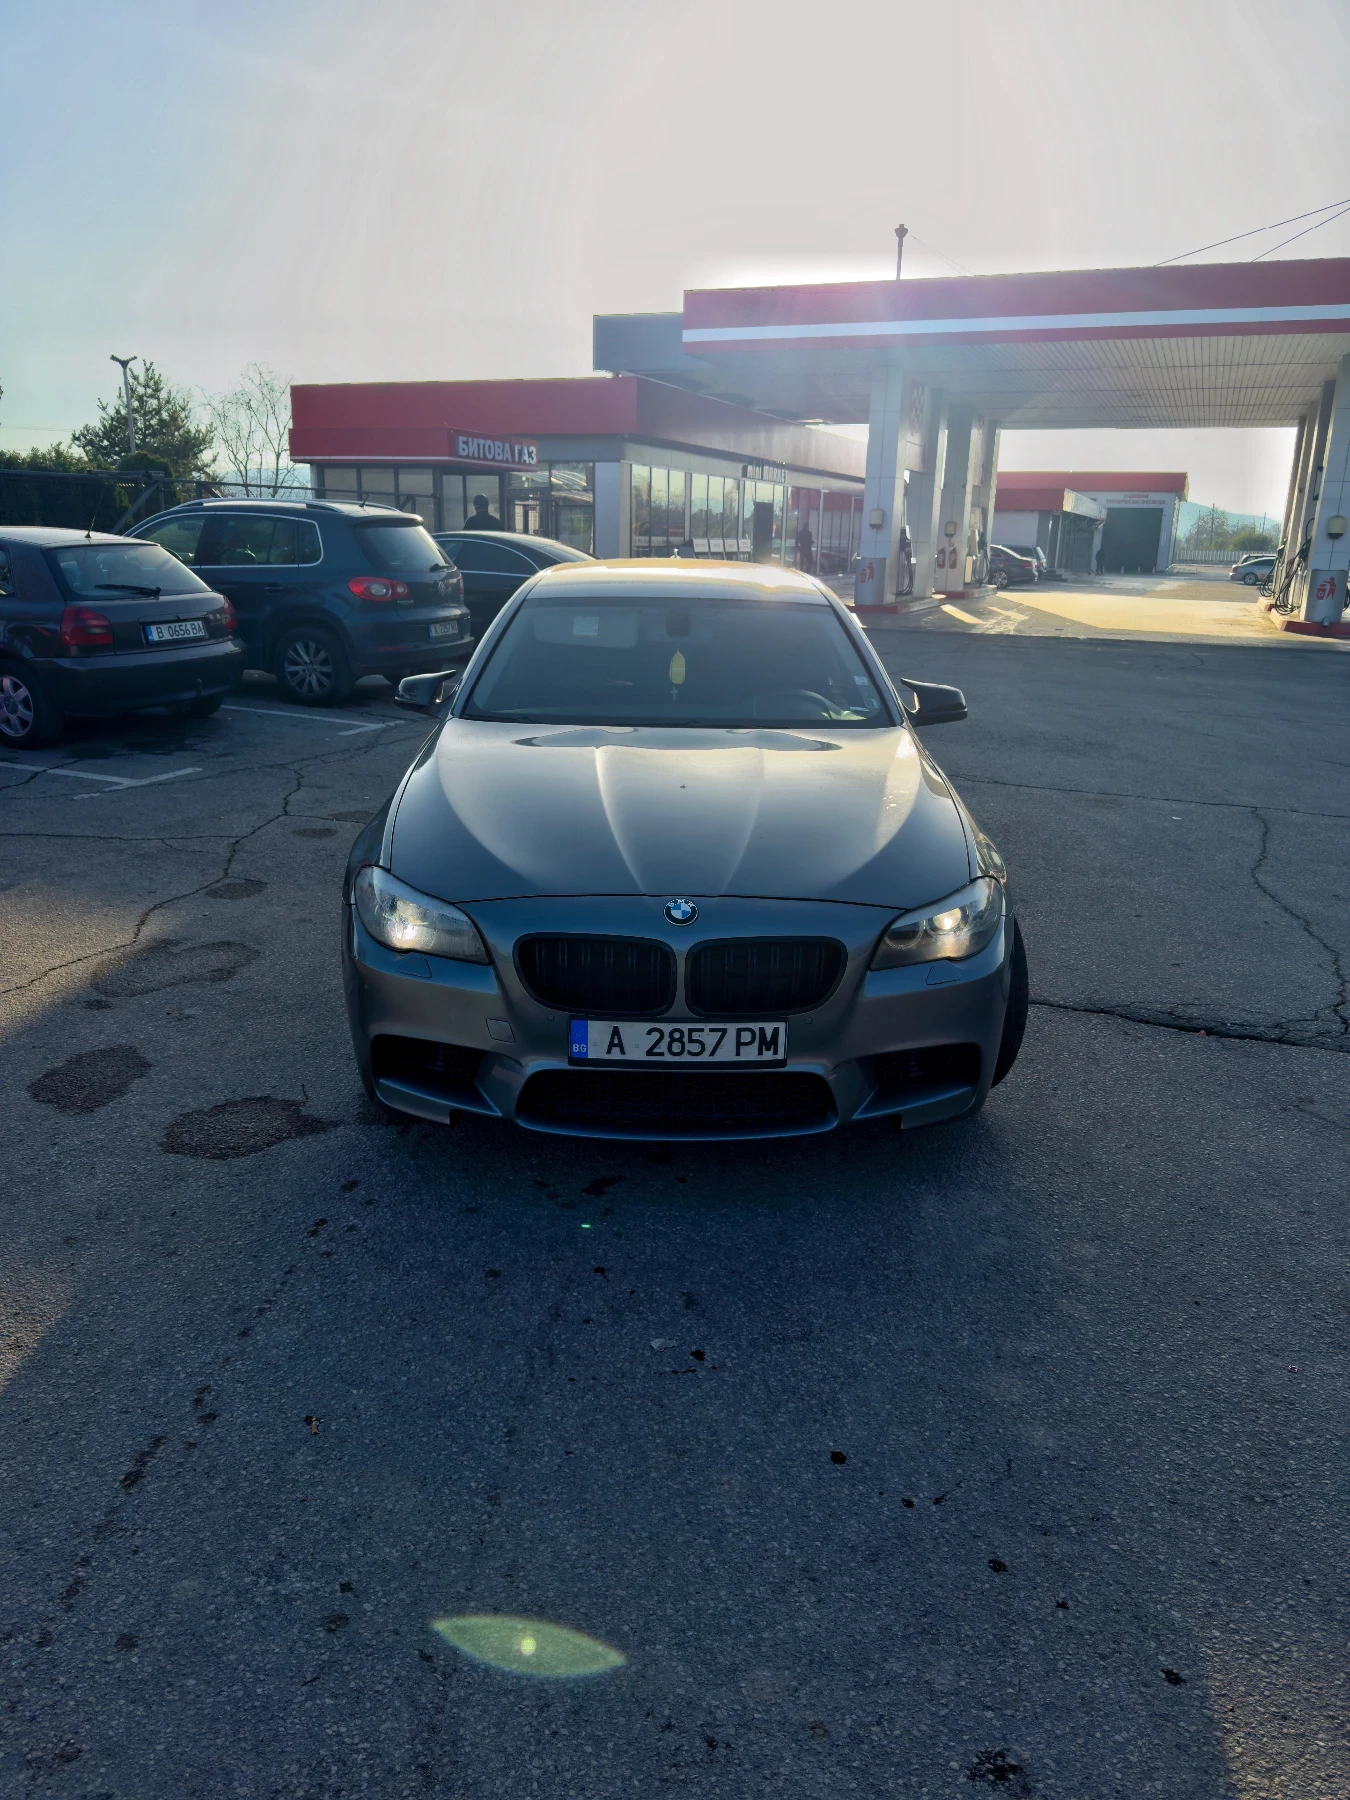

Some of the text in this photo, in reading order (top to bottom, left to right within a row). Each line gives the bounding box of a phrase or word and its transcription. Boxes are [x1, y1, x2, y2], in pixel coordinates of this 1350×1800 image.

[458, 436, 537, 465] БИТОВА ГАЗ
[156, 622, 205, 639] B 0656 BA
[572, 1025, 780, 1057] BG A 2857 PM
